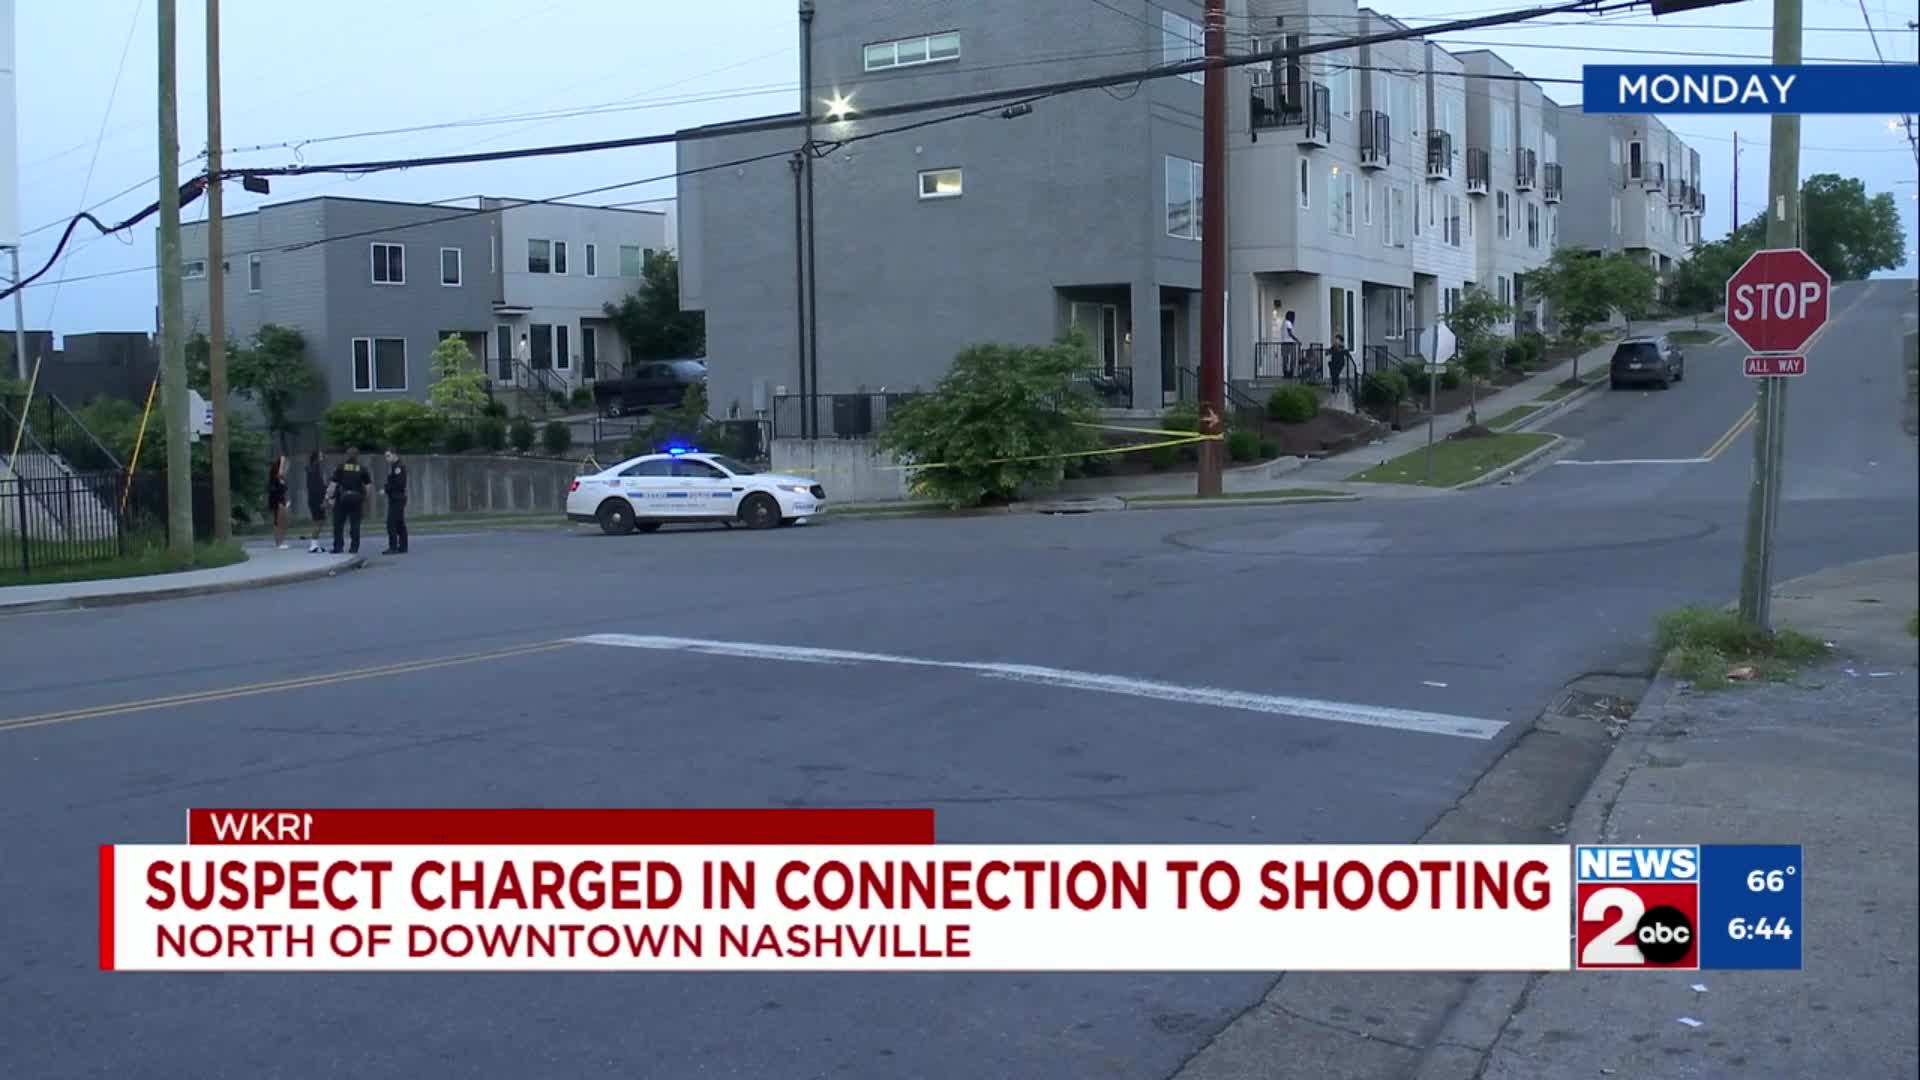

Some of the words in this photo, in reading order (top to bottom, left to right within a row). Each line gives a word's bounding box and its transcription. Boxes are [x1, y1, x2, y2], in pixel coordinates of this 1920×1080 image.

[1734, 282, 1821, 321] STOP
[1749, 360, 1769, 372] ALL
[1778, 360, 1800, 372] WAY
